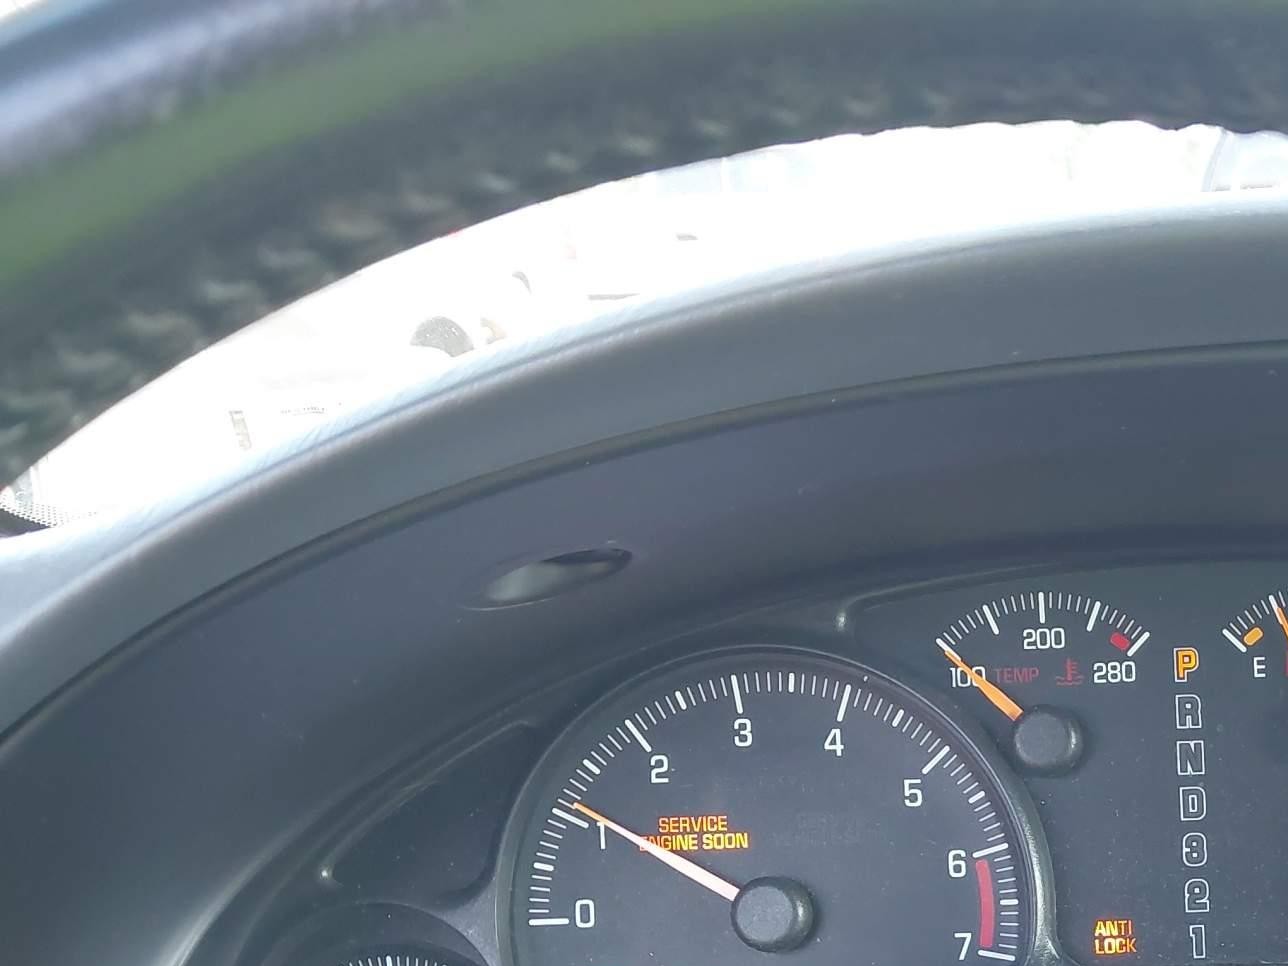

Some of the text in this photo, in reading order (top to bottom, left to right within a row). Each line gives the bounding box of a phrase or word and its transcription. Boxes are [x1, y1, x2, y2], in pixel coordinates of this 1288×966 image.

[1023, 627, 1065, 650] 200
[950, 665, 987, 688] 100
[993, 667, 1040, 684] TEMP
[1093, 661, 1136, 684] 280
[1173, 647, 1199, 683] P
[1253, 657, 1266, 678] E
[1175, 694, 1202, 729] R
[734, 719, 753, 747] 3
[824, 729, 844, 757] 4
[650, 755, 669, 783] 2
[1176, 741, 1206, 776] N
[903, 779, 922, 807] 5
[1178, 786, 1207, 821] D
[596, 820, 606, 850] 1
[658, 815, 728, 833] SERVICE
[702, 832, 749, 850] SOON
[1182, 832, 1208, 867] 3
[948, 850, 966, 877] 6
[1184, 879, 1210, 913] 2
[575, 900, 595, 928] 0
[1094, 920, 1133, 937] ANTI
[1188, 924, 1206, 959] 1
[954, 933, 972, 961] 7
[1094, 937, 1137, 955] LOCK
